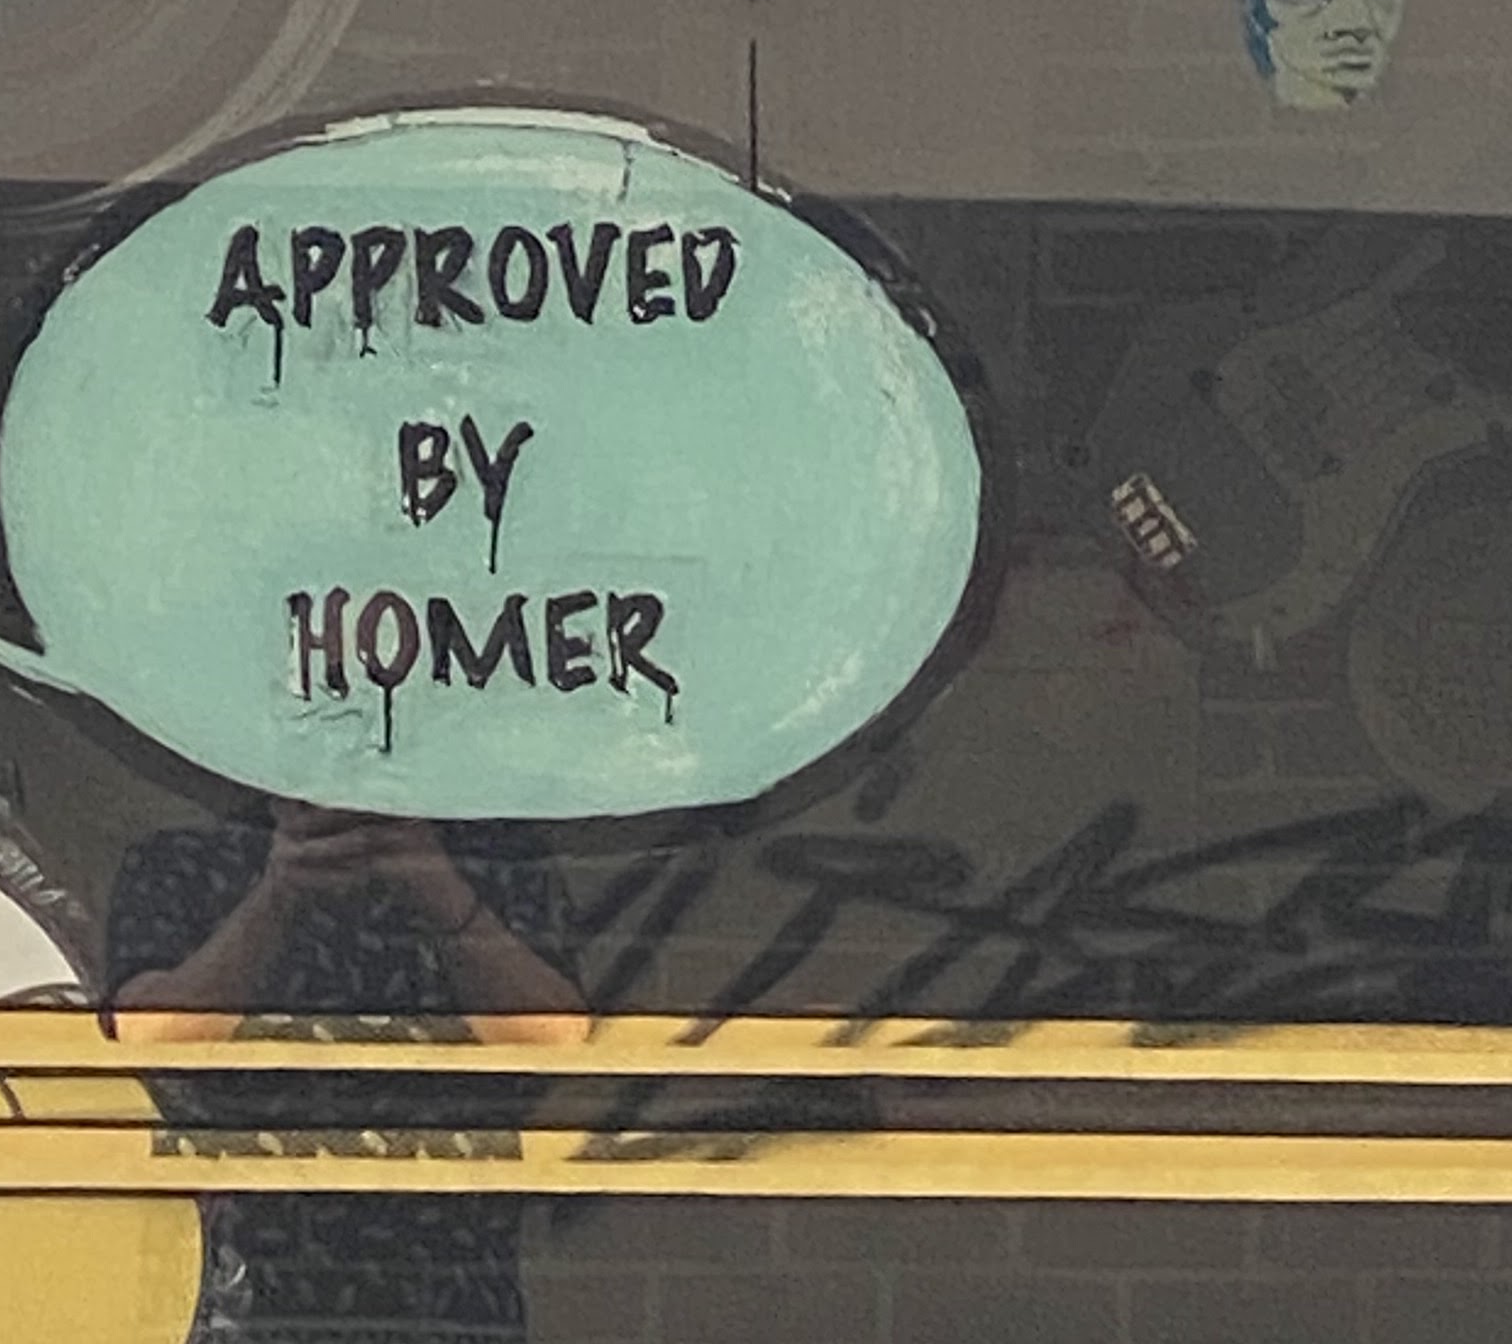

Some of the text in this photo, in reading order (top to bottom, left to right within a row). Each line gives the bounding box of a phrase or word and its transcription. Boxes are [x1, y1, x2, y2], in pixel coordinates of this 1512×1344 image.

[205, 220, 742, 346] APPROVED
[397, 413, 536, 541] BY
[286, 583, 680, 713] HOMER
